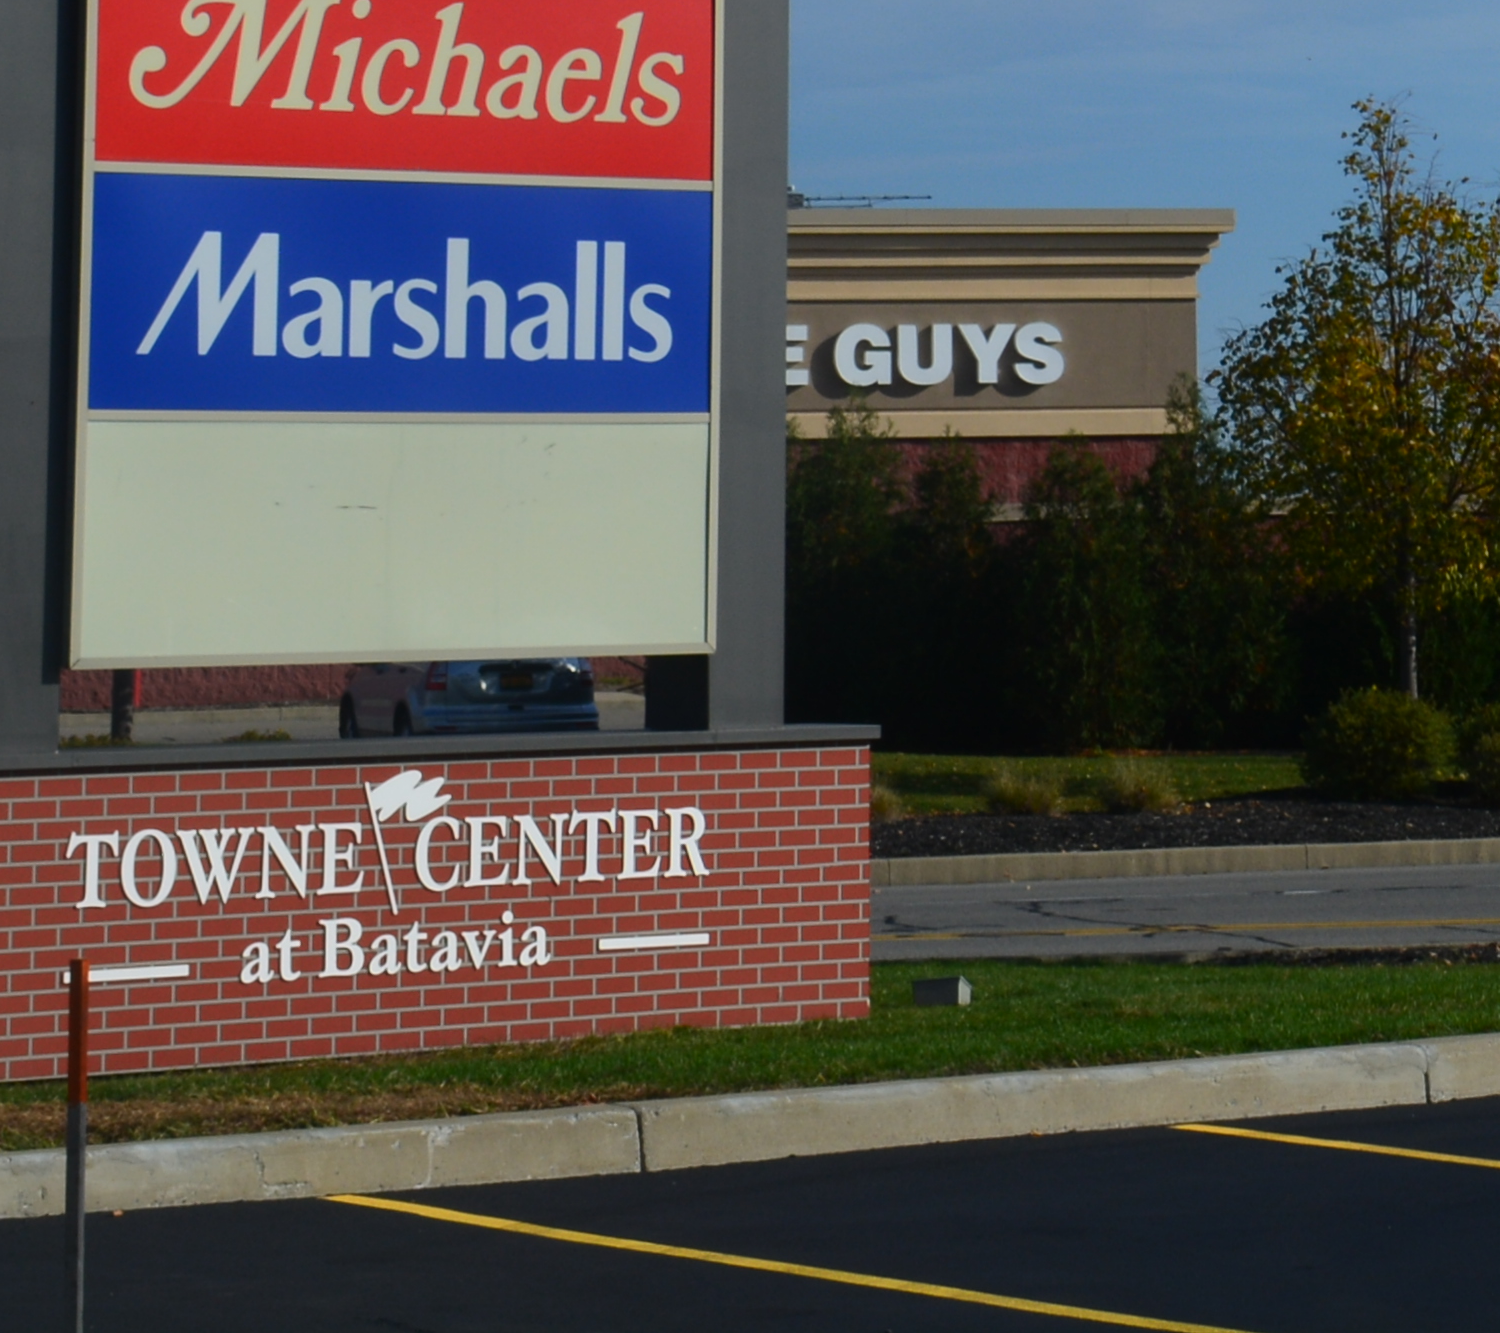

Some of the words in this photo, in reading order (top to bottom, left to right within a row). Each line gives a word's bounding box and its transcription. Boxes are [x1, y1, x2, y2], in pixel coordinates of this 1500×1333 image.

[136, 230, 674, 363] Marshalls
[833, 321, 1065, 387] GUYS
[65, 822, 365, 910] TOWNE
[414, 806, 710, 893] CENTER
[240, 930, 302, 985] at
[318, 911, 552, 979] Batavia
